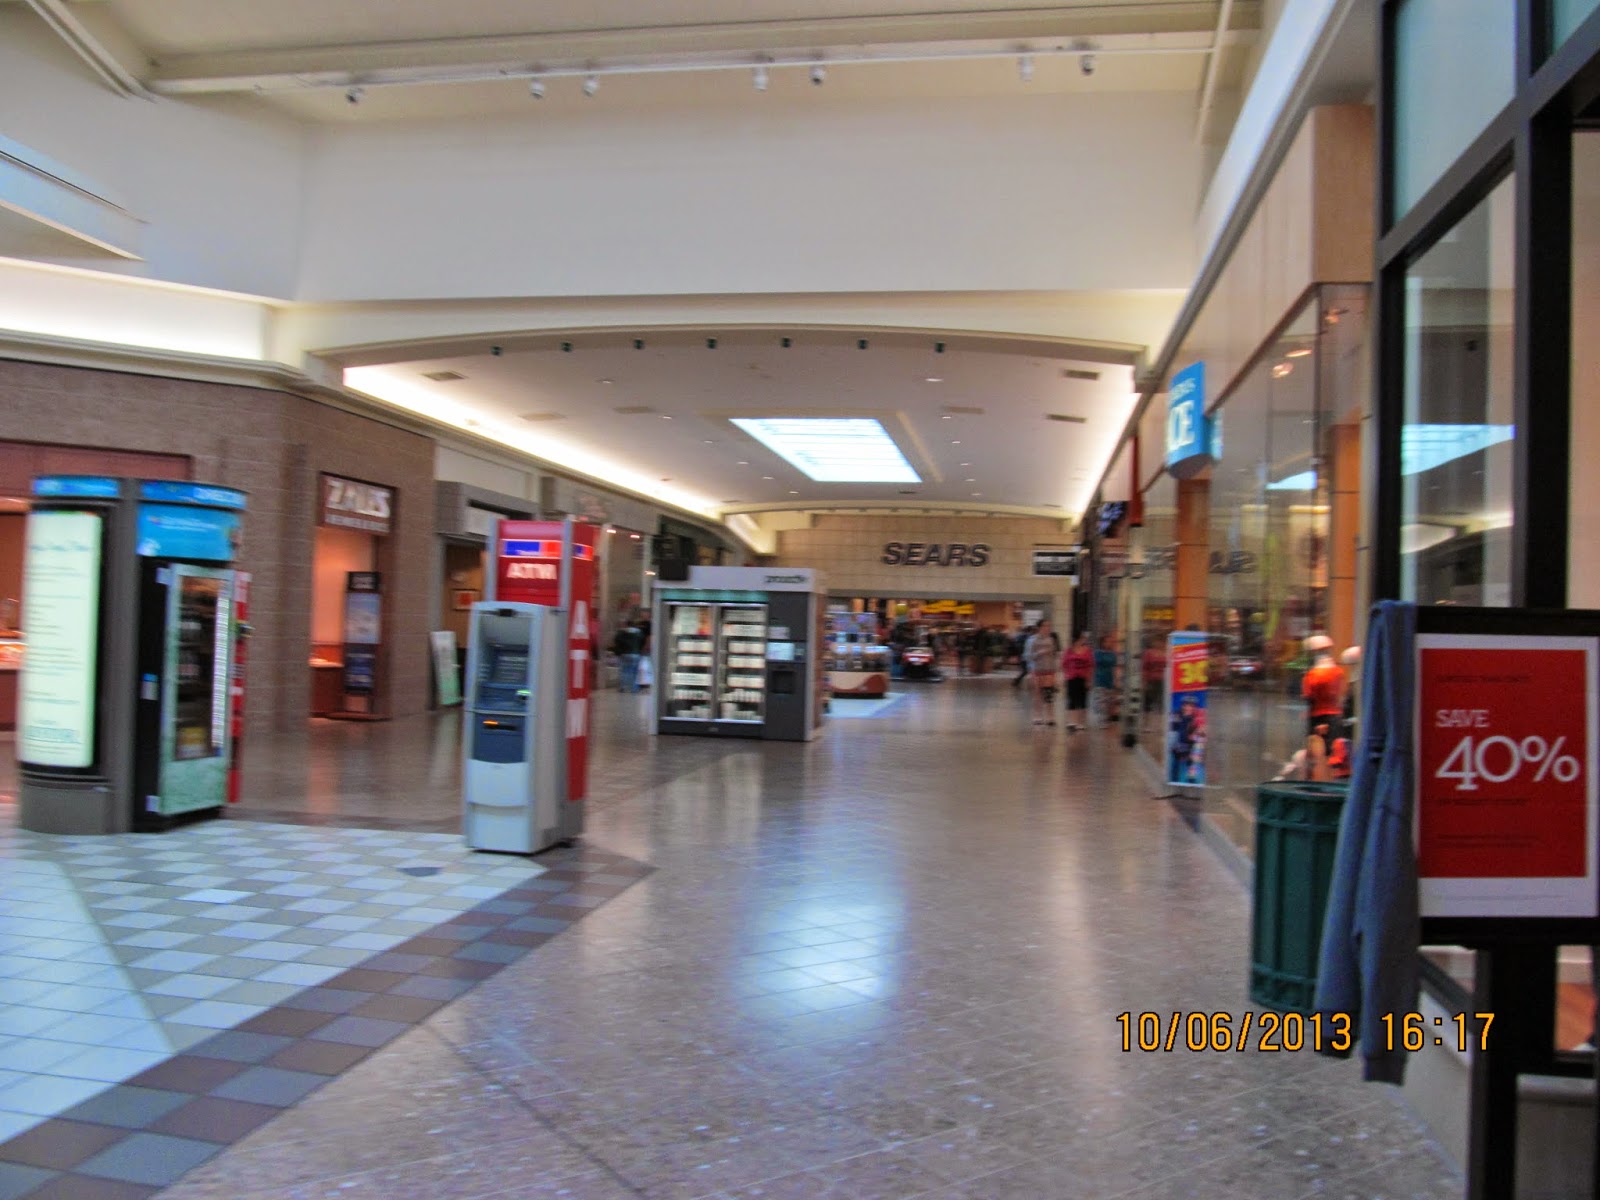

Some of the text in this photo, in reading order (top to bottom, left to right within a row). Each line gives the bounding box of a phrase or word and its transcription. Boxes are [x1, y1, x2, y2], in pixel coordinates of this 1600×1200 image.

[882, 541, 990, 567] SEARS
[1434, 708, 1491, 728] SAVE
[1434, 734, 1581, 791] 40%
